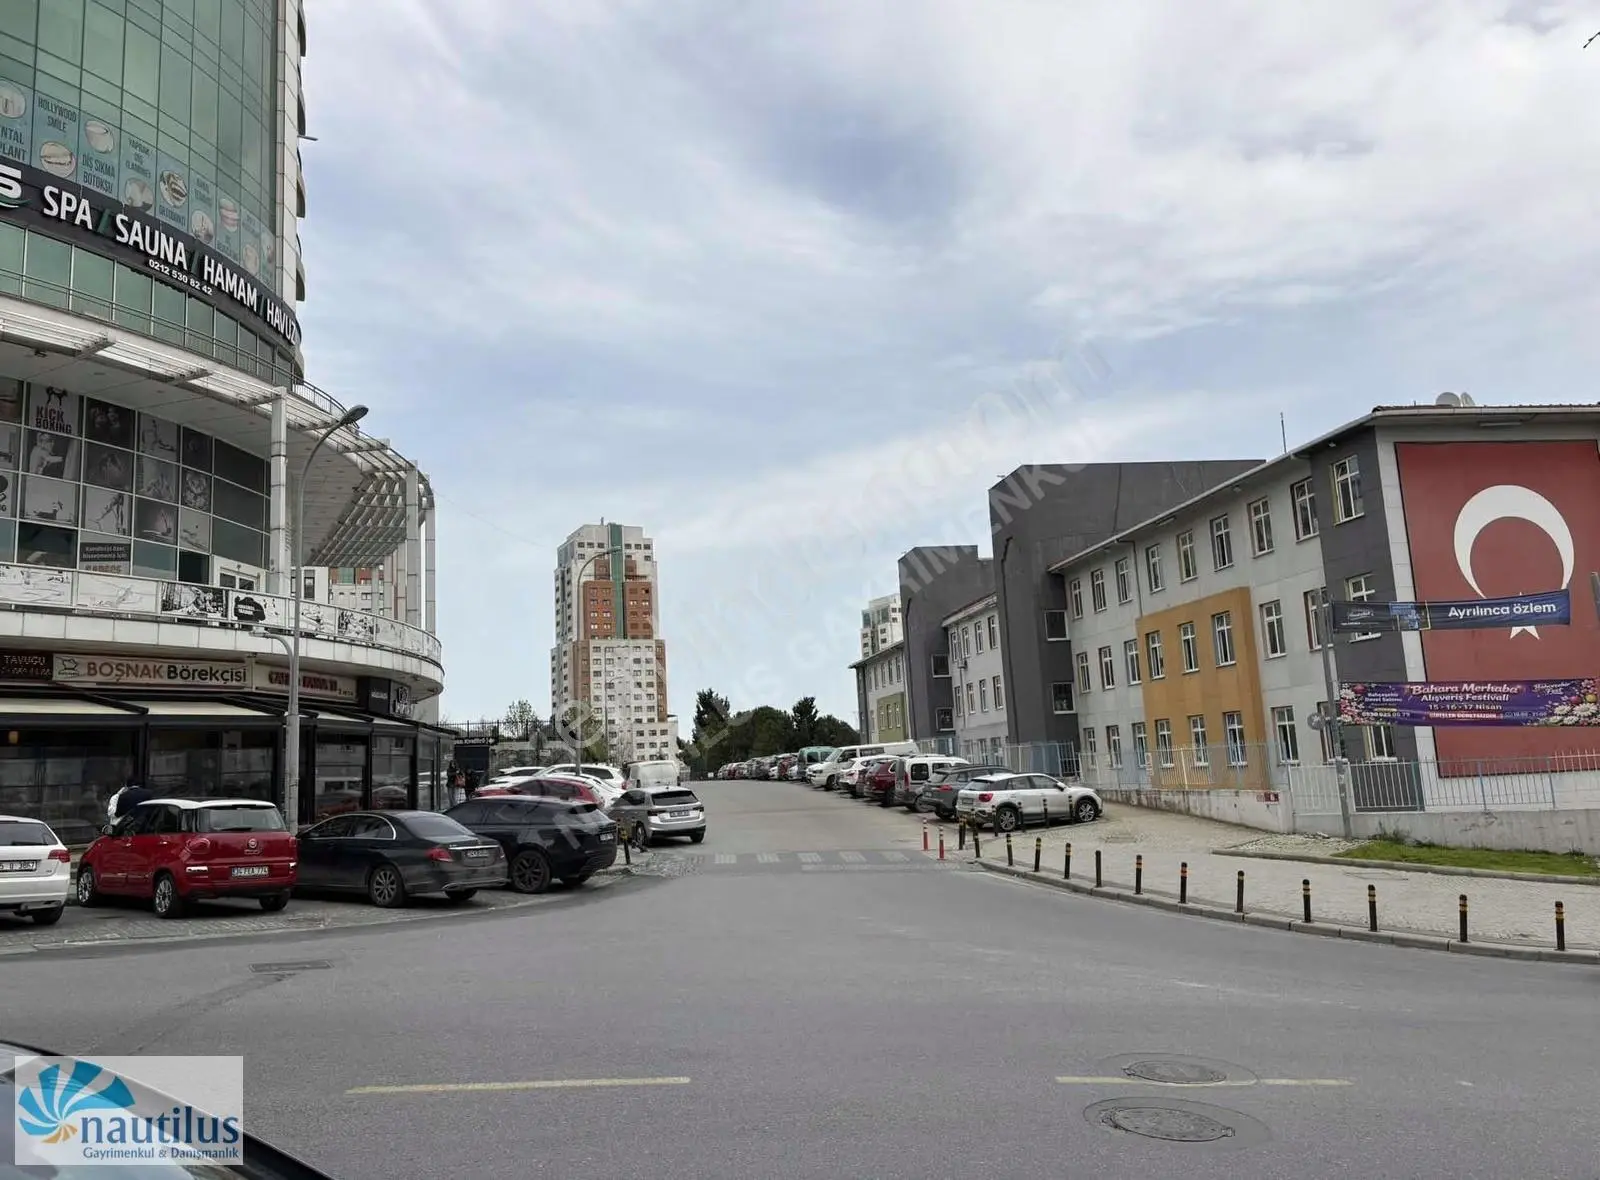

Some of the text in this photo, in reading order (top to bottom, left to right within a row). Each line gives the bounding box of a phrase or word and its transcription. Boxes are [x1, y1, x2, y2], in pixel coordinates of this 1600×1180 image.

[43, 185, 93, 230] SPA
[116, 214, 187, 271] SAUNA
[204, 254, 258, 312] HAMAM
[267, 298, 297, 346] HAVUZ
[149, 259, 213, 296] 0212 530 82 42
[36, 405, 64, 420] KICK
[35, 417, 72, 435] BOXING
[1448, 600, 1557, 619] Ayrılınca özlem
[87, 660, 164, 682] BOŞNAK
[167, 660, 247, 684] Börekçisi
[1421, 693, 1510, 702] Alışveriş Festivali
